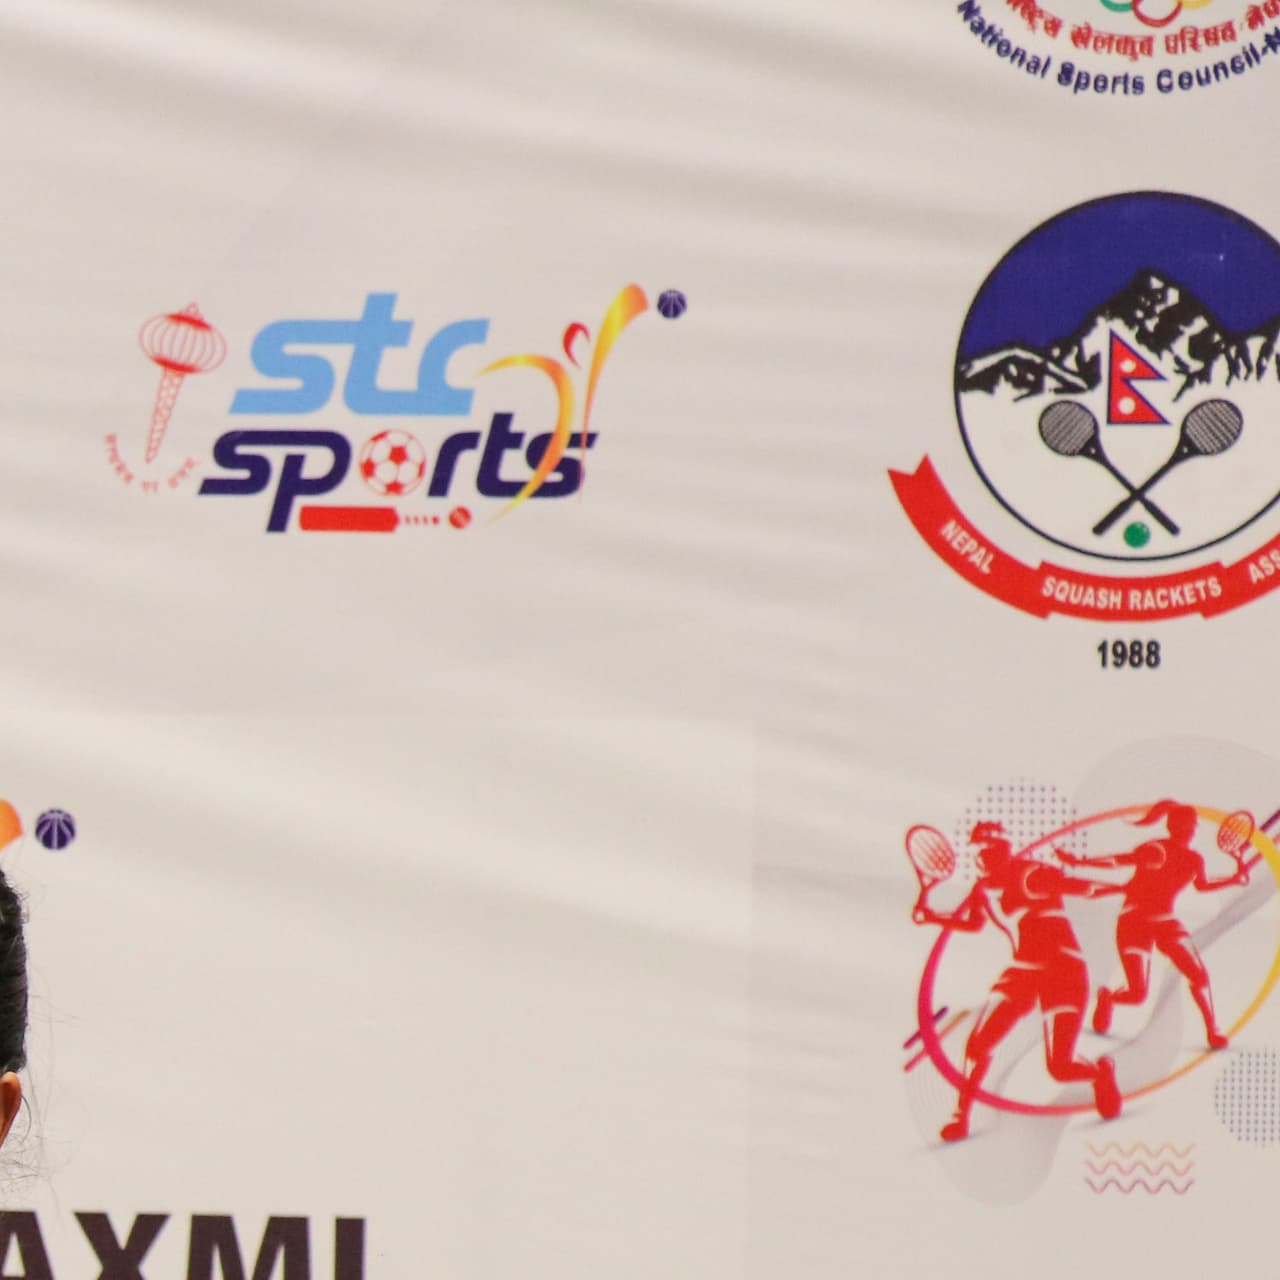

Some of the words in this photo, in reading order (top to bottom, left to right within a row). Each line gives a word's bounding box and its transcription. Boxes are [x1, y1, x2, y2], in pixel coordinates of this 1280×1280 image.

[1057, 60, 1145, 96] Sports
[227, 292, 491, 417] stc
[939, 518, 996, 576] NEPAL
[1040, 576, 1123, 611] SQUASH
[1128, 576, 1223, 612] RACKETS
[1096, 639, 1162, 669] 1988
